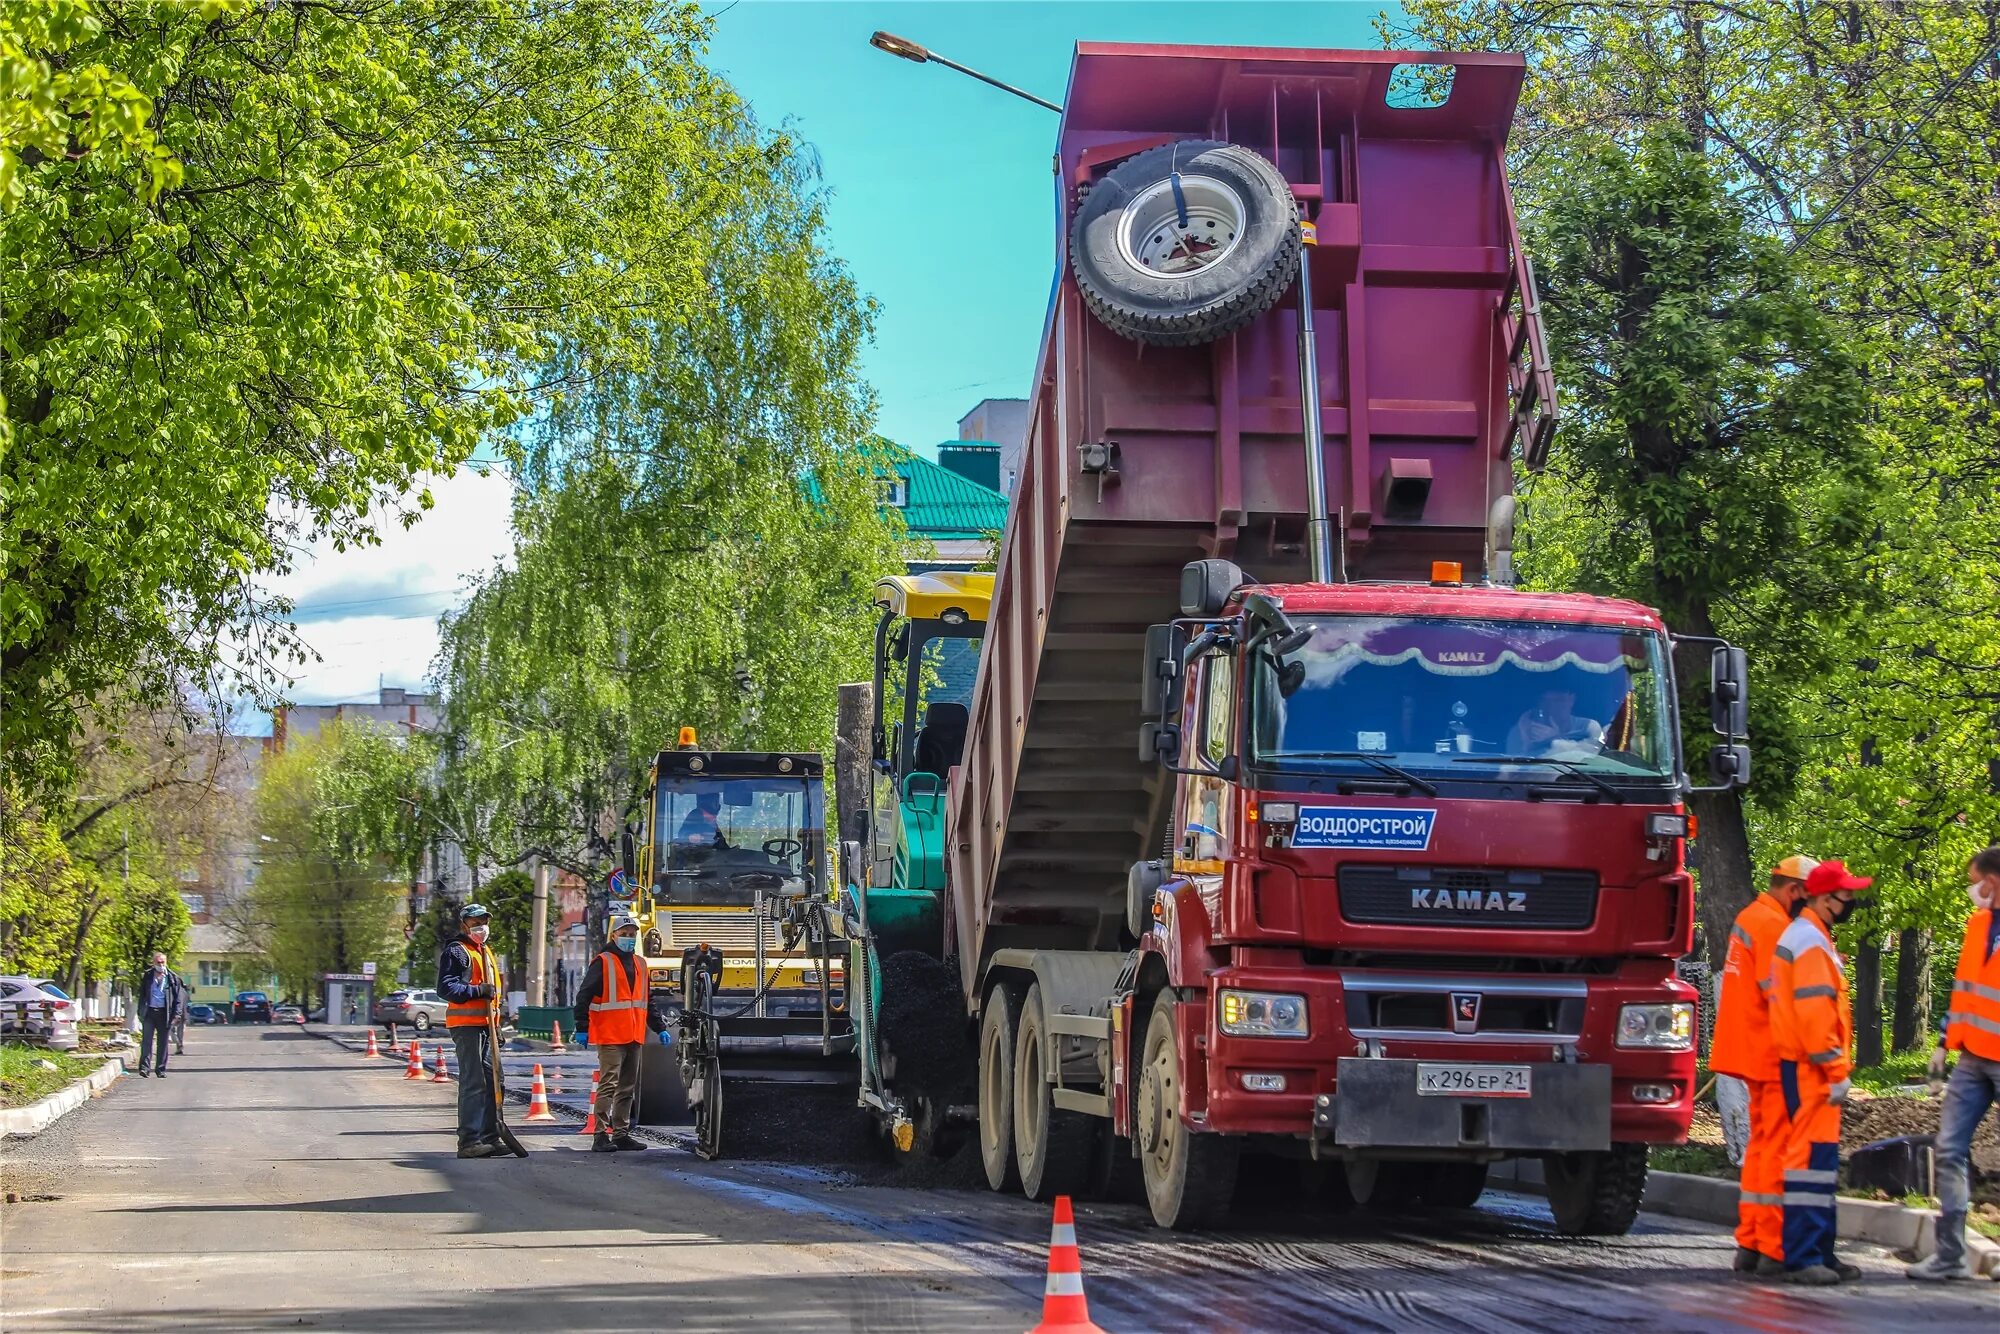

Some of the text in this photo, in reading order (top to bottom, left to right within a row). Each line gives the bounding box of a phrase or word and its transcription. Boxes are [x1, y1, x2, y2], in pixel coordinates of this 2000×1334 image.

[1438, 651, 1486, 662] KAMAZ
[1299, 815, 1426, 836] ВОДДОРСТРОЙ
[1411, 888, 1527, 912] KAMAZ
